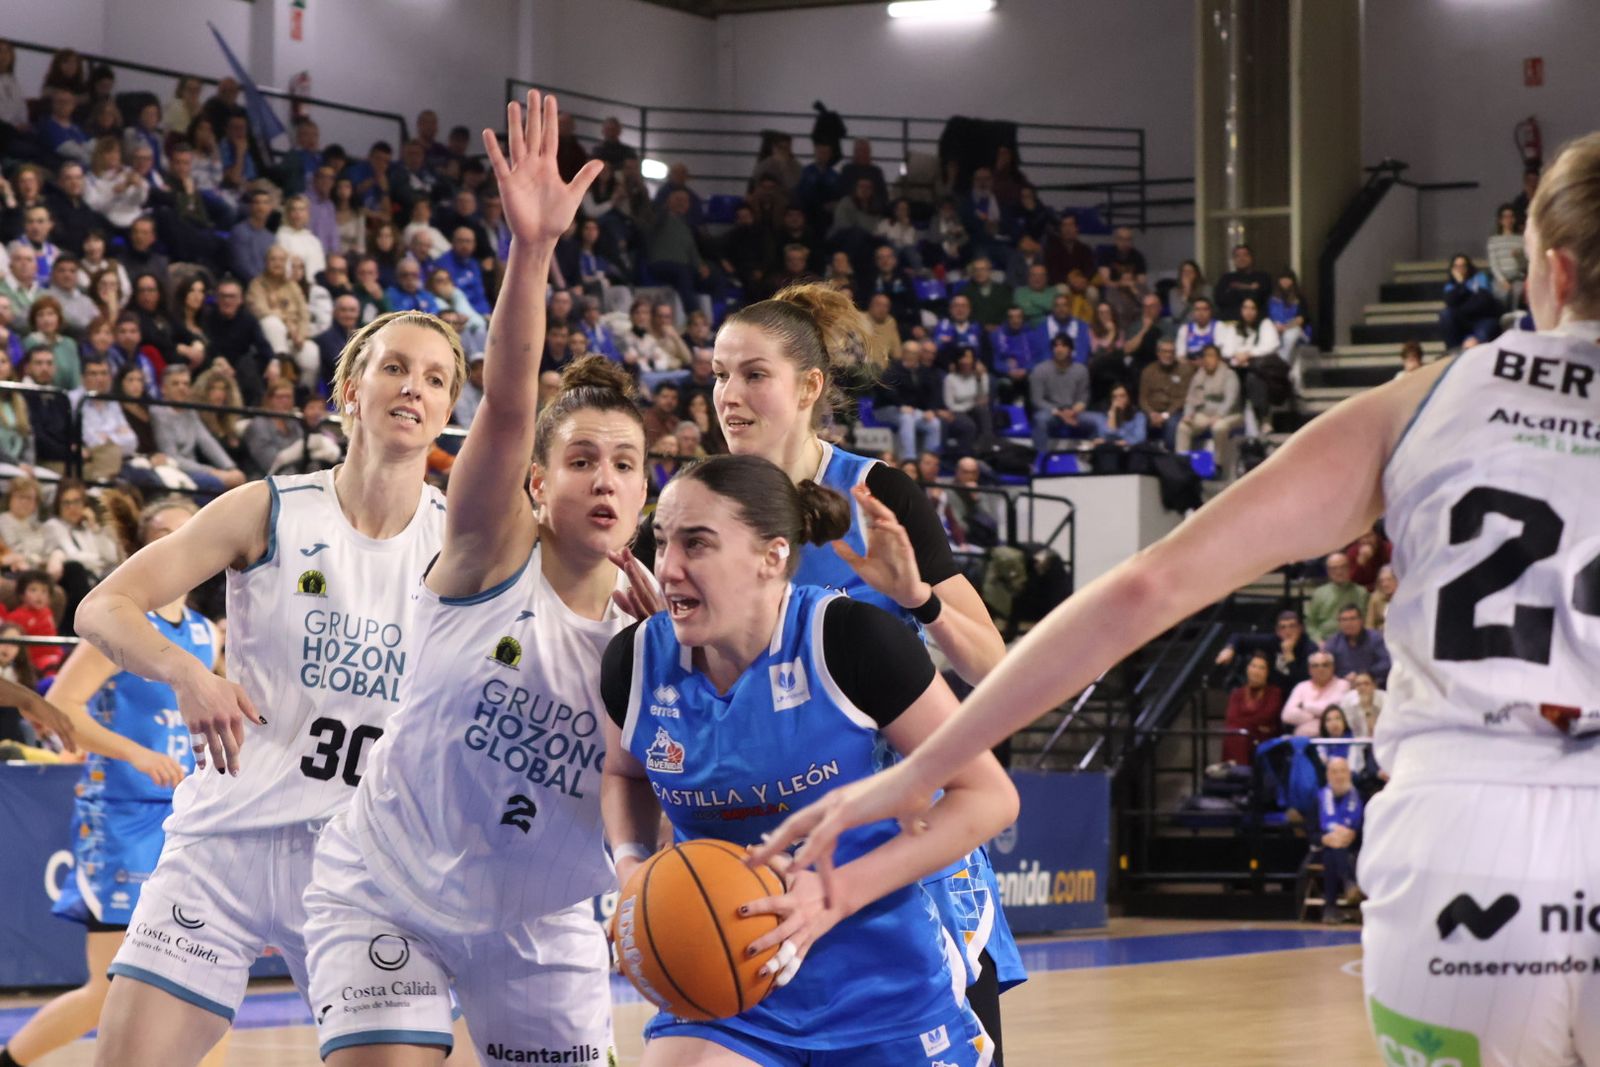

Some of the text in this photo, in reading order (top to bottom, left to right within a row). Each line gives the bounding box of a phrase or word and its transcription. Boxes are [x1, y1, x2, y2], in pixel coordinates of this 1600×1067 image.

[1493, 348, 1600, 398] BER
[1434, 485, 1600, 665] 2
[304, 609, 402, 648] GRUPO
[300, 662, 400, 702] GLOBAL
[482, 679, 597, 738] GRUPO
[300, 716, 384, 788] 30
[464, 724, 583, 798] GLOBAL
[648, 758, 682, 770] AVENIDA
[652, 760, 839, 807] CASTILLA Y LEÓN
[501, 794, 537, 834] 2
[996, 859, 1096, 906] enida.com
[136, 921, 219, 964] Costa Cálida
[1428, 955, 1588, 976] Conservando
[342, 981, 438, 1001] Costa Cálida
[486, 1043, 600, 1064] Alcantarilla
